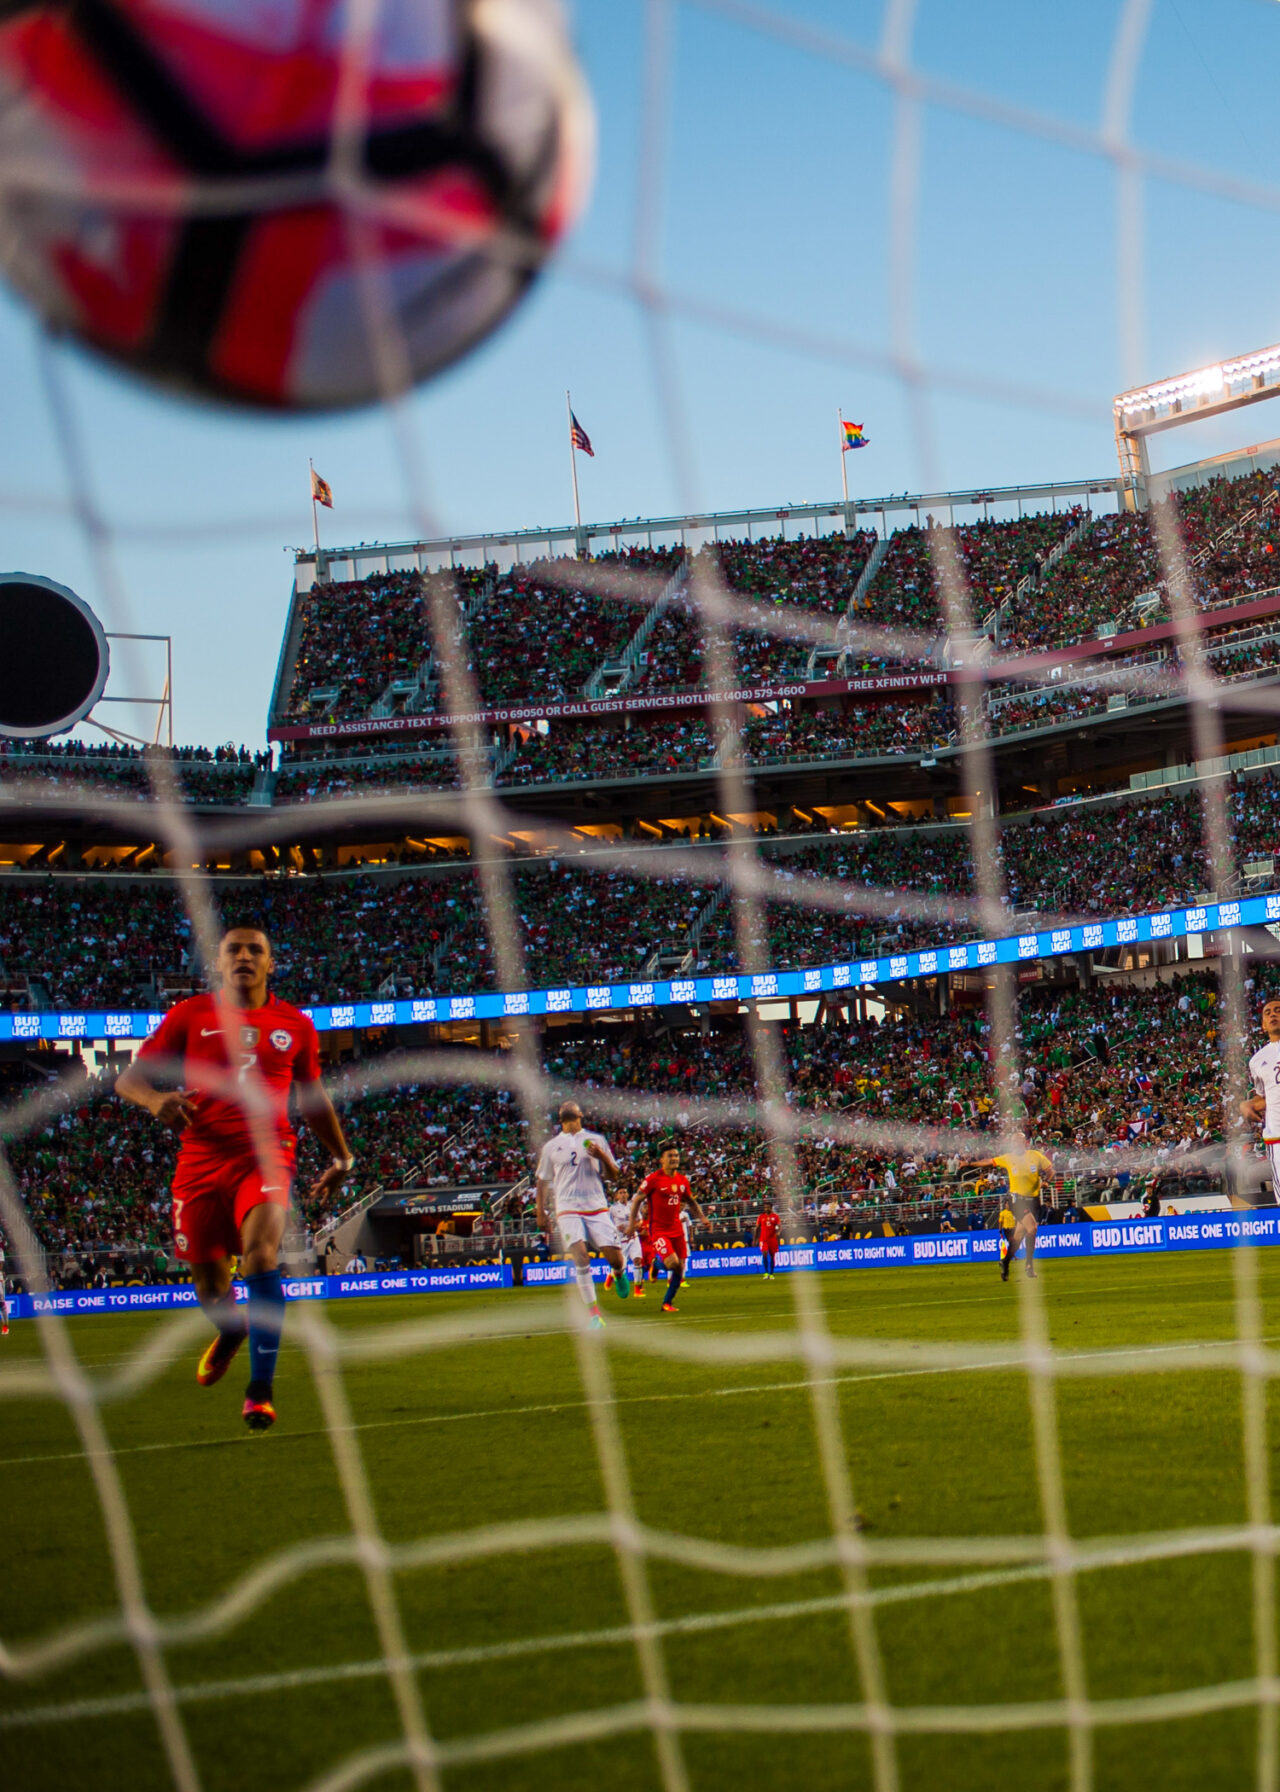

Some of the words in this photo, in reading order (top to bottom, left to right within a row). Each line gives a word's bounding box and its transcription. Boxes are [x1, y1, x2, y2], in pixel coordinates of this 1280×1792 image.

[847, 679, 874, 690] FREE
[875, 676, 918, 688] XFINITY
[920, 673, 947, 684] WI-FI
[309, 726, 336, 736] NEED
[339, 720, 404, 733] ASSISTANCE?
[407, 717, 433, 728] TEXT
[494, 711, 508, 719] TO
[510, 708, 543, 718] 69050
[546, 706, 561, 716] OR
[563, 703, 589, 714] CALL
[590, 702, 623, 712] GUEST
[625, 696, 675, 709] SERVICES
[677, 693, 723, 705] HOTLINE
[724, 689, 752, 701] (408)
[754, 685, 806, 698] 579-4600
[1219, 903, 1239, 915] BUD
[1218, 912, 1241, 926] LIGHT
[1084, 925, 1102, 937] BUD
[1019, 936, 1037, 947] BUD
[1082, 935, 1103, 947] LIGHT
[1018, 945, 1039, 957] LIGHT
[890, 957, 907, 967] BUD
[833, 966, 849, 977] BUD
[890, 965, 908, 977] LIGHT
[713, 978, 736, 988] BUD
[833, 975, 850, 986] LIGHT
[587, 988, 610, 998] BUD
[630, 984, 653, 995] BUD
[712, 987, 738, 998] LIGHT
[451, 998, 473, 1008] BUD
[505, 994, 527, 1004] BUD
[586, 997, 611, 1008] LIGHT
[628, 993, 654, 1004] LIGHT
[332, 1007, 353, 1017] BUD
[450, 1007, 475, 1018] LIGHT
[504, 1003, 529, 1014] LIGHT
[14, 1016, 39, 1026] BUD
[60, 1016, 85, 1025] BUD
[330, 1016, 355, 1027] LIGHT
[12, 1026, 40, 1036] LIGHT
[59, 1025, 86, 1036] LIGHT
[238, 1054, 257, 1084] 7
[571, 1151, 577, 1166] 2
[438, 1203, 473, 1212] STADIUM
[173, 1199, 184, 1230] 7
[1169, 1226, 1199, 1240] RAISE
[1201, 1224, 1223, 1239] ONE
[1225, 1222, 1240, 1237] TO
[1242, 1220, 1275, 1236] RIGHT
[1059, 1233, 1083, 1247] NOW.
[1092, 1228, 1121, 1248] BUD
[1122, 1225, 1162, 1245] LIGHT
[653, 1238, 666, 1250] 20
[914, 1241, 937, 1258] BUD
[937, 1239, 968, 1257] LIGHT
[973, 1240, 997, 1252] RAISE
[790, 1250, 814, 1265] LIGHT
[818, 1250, 838, 1262] RAISE
[839, 1249, 853, 1260] ONE
[853, 1248, 864, 1259] TO
[864, 1247, 885, 1258] RIGHT
[692, 1259, 708, 1269] RAISE
[709, 1258, 720, 1268] ONE
[721, 1257, 729, 1267] TO
[730, 1256, 747, 1266] RIGHT
[527, 1267, 545, 1281] BUD
[546, 1266, 567, 1280] LIGHT
[341, 1279, 377, 1291] RAISE
[381, 1278, 407, 1289] ONE
[410, 1277, 427, 1287] TO
[430, 1274, 467, 1285] RIGHT
[470, 1272, 502, 1283] NOW.
[281, 1282, 323, 1297] IGHT
[33, 1299, 73, 1310] RAISE
[78, 1297, 105, 1307] ONE
[109, 1295, 127, 1305] TO
[130, 1292, 168, 1304] RIGHT
[173, 1291, 197, 1302] NO
